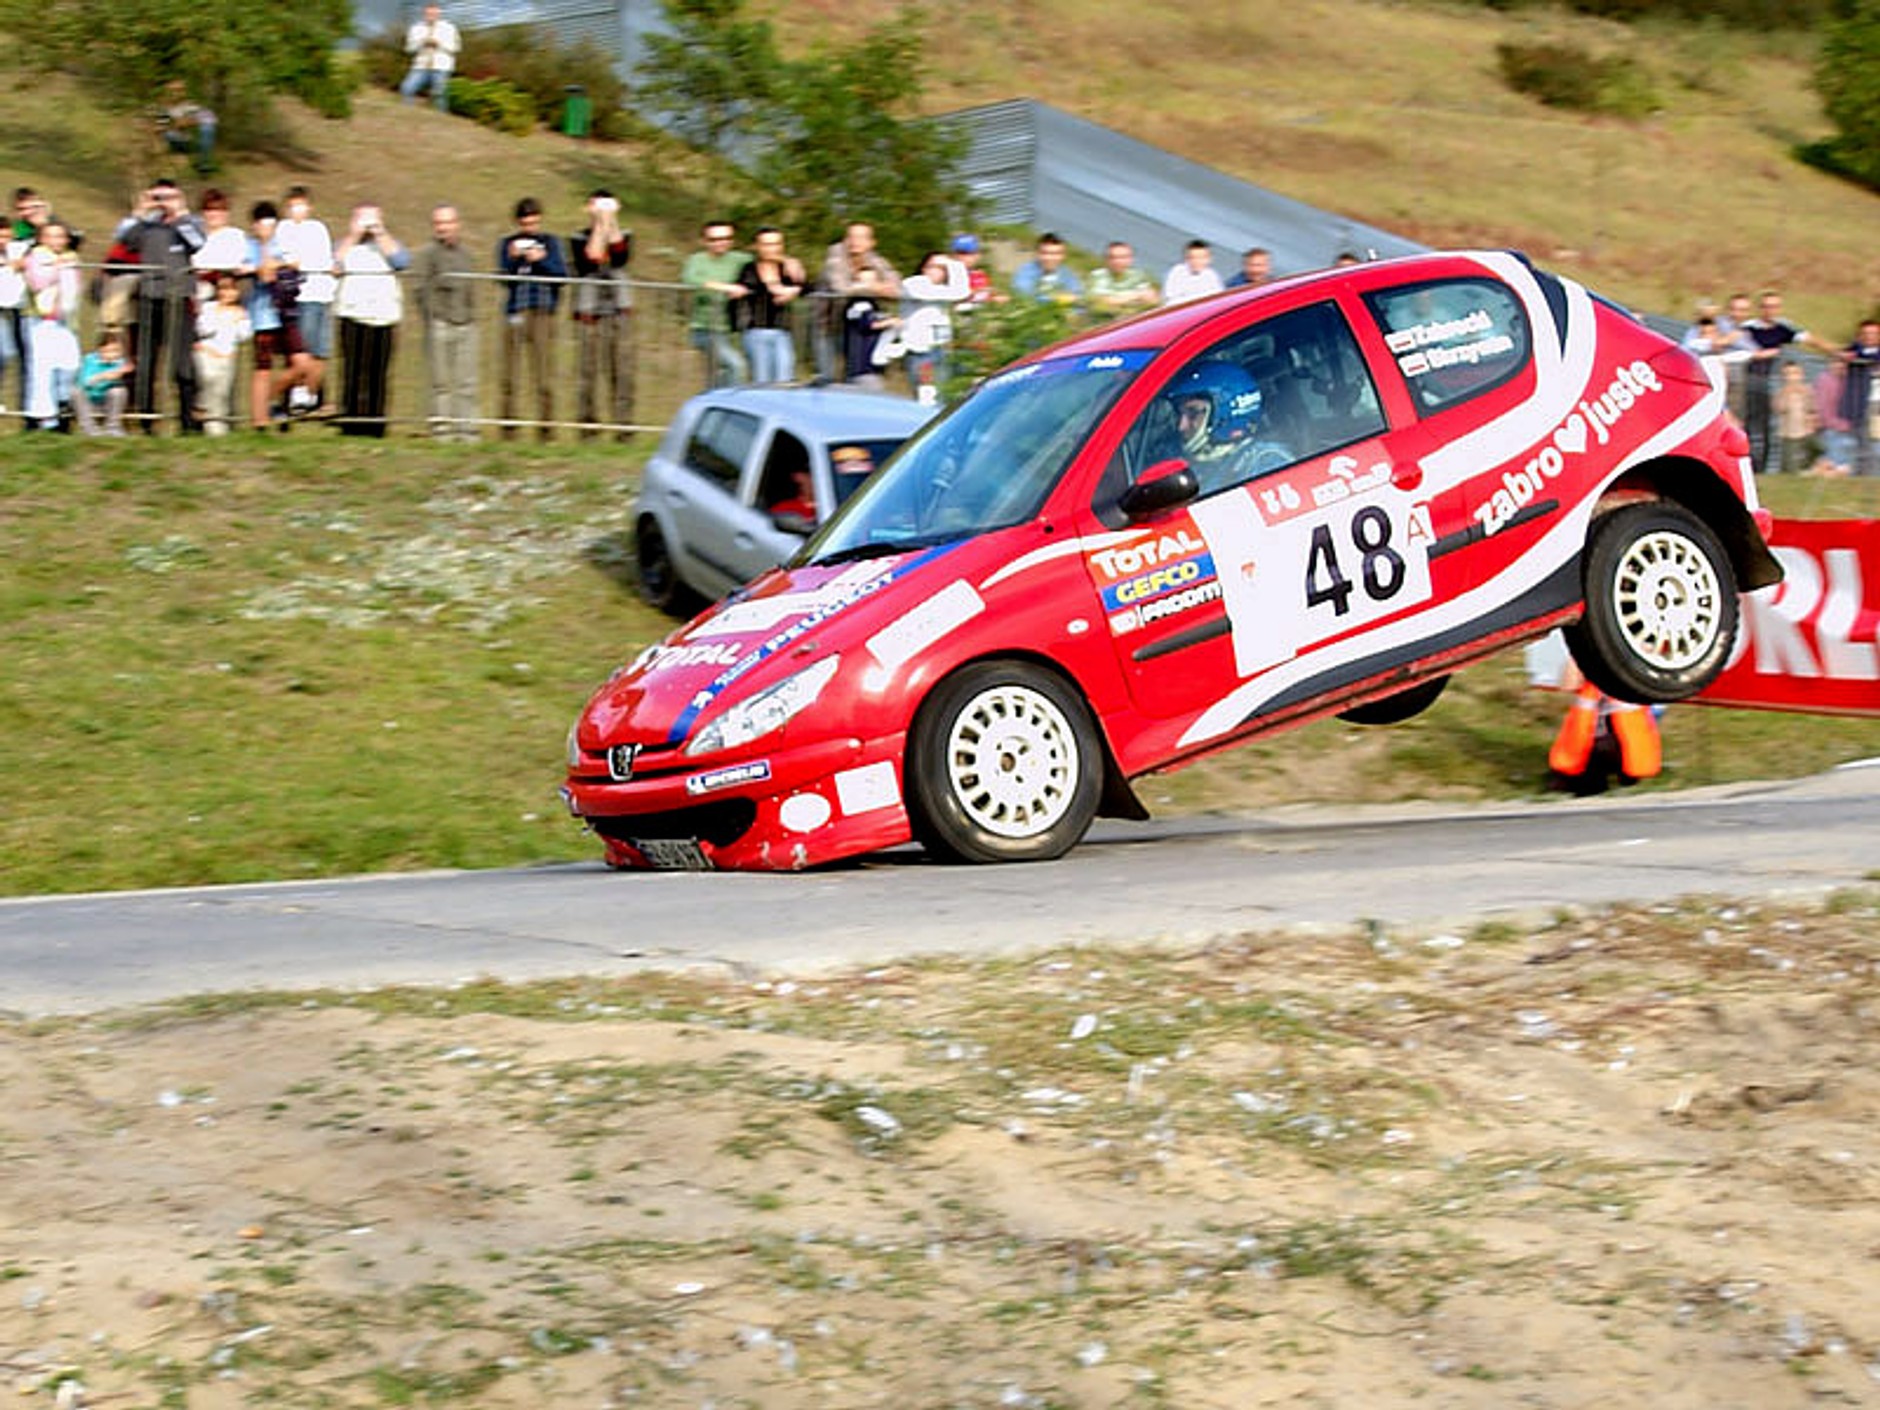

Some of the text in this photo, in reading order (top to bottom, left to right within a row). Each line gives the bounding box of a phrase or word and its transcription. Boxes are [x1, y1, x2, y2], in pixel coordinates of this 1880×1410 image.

[1473, 446, 1564, 536] zabro
[1091, 531, 1205, 579] TOTAL
[1115, 561, 1201, 604] GEFCO
[1305, 505, 1406, 617] 48
